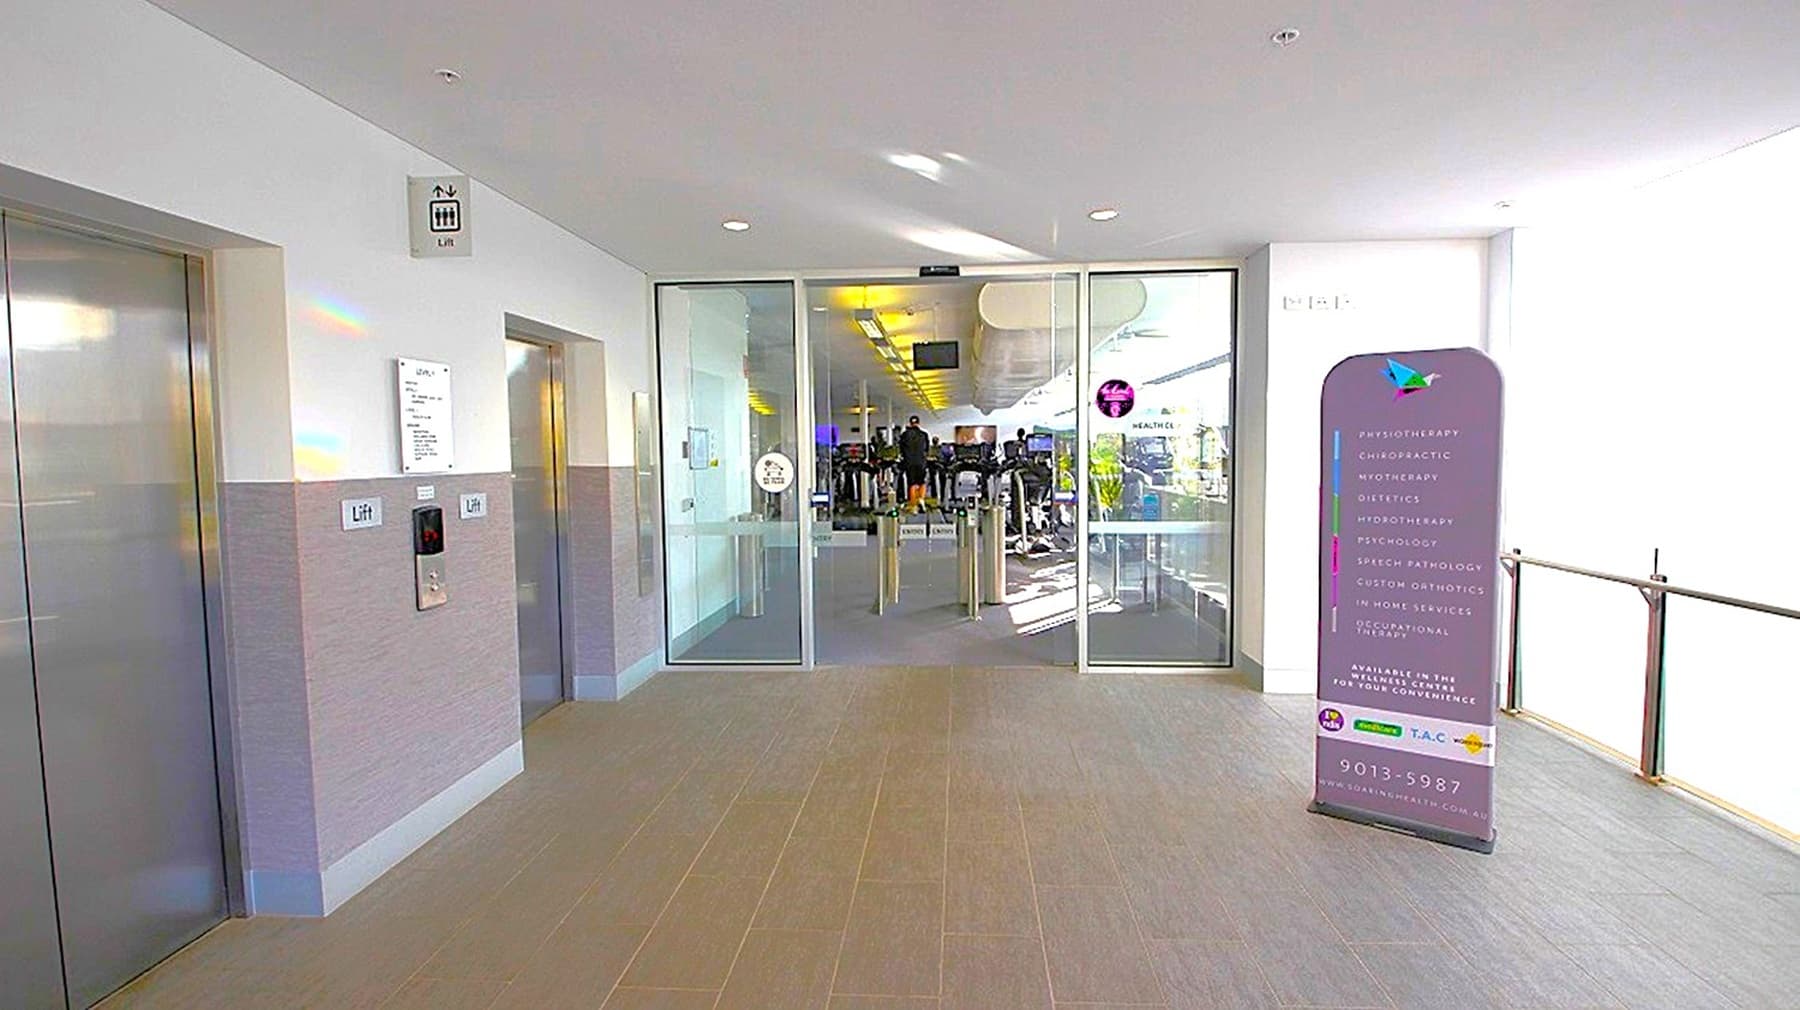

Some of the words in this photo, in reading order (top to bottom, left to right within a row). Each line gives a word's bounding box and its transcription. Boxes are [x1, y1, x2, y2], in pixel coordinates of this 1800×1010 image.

[438, 238, 454, 247] Lift
[1132, 422, 1163, 430] HEALTH
[1359, 430, 1460, 439] PHYSIOTHERAPY
[1359, 451, 1451, 461] CHIROPRACTIC
[1359, 473, 1439, 482] MYOTHERAPY
[466, 498, 481, 514] Lift
[1358, 494, 1420, 504] DIETETICS
[353, 504, 373, 522] Lift
[1357, 516, 1454, 526] HYDROTHERAPY
[1357, 537, 1438, 548] PSYCHOLOGY
[1357, 557, 1401, 568] SPEECH
[1408, 561, 1482, 572] PATHOLOGY
[1356, 577, 1405, 588] CUSTOM
[1412, 582, 1485, 595] ORTHOTICS
[1356, 599, 1368, 607] IN
[1374, 600, 1407, 610] HOME
[1413, 603, 1472, 616] SERVICES
[1356, 620, 1449, 636] OCCUPATIONAL
[1356, 628, 1407, 639] THERAPY
[1351, 664, 1412, 679] AVAILABLE
[1416, 671, 1429, 681] IN
[1434, 674, 1456, 684] THE
[1351, 673, 1407, 687] WELLNESS
[1411, 680, 1456, 694] CENTRE
[1333, 678, 1353, 688] FOR
[1359, 682, 1388, 692] YOUR
[1392, 687, 1476, 705] CONVENIENCE
[1411, 728, 1446, 743] T.A.C
[1340, 759, 1461, 795] 9013-5987
[1319, 779, 1488, 820] WWW.SOARINGHEALTH.COM.AU
